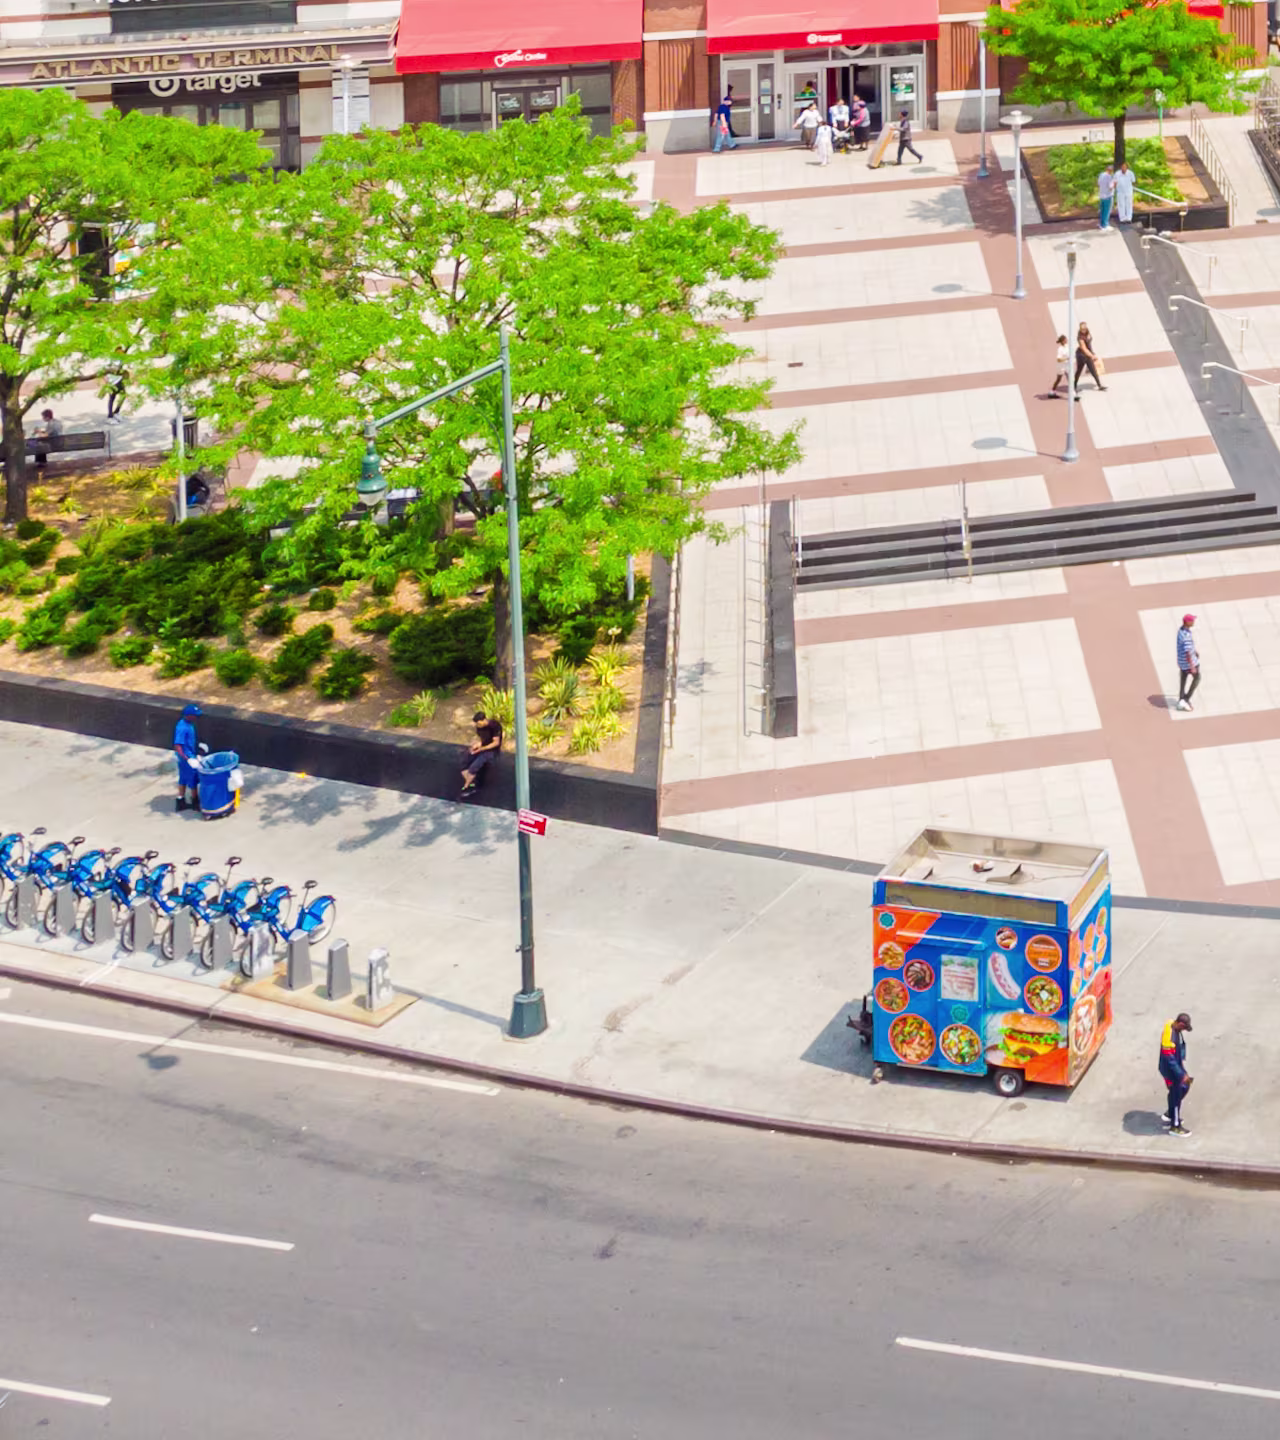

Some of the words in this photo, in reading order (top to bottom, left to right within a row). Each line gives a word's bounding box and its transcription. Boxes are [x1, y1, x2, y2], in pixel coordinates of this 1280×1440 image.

[30, 54, 180, 80] ATLANTIC
[193, 44, 346, 68] TERMINAL
[185, 72, 261, 93] target
